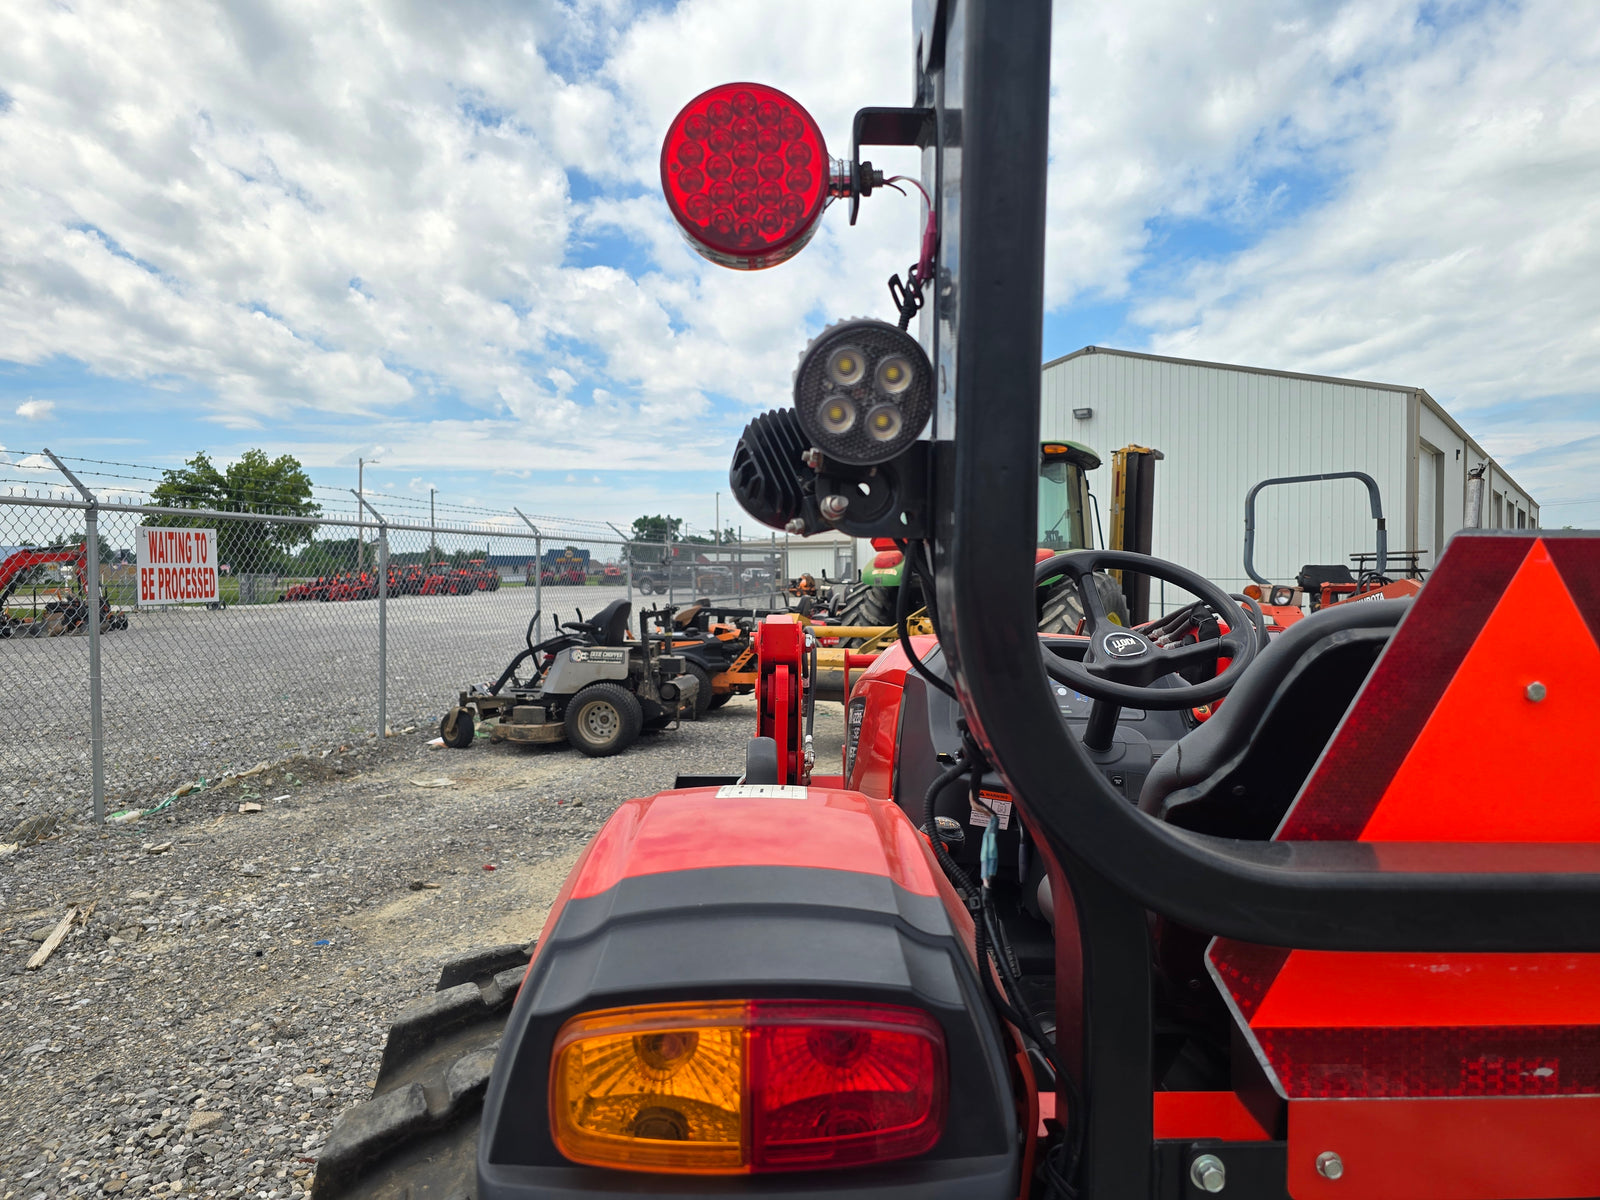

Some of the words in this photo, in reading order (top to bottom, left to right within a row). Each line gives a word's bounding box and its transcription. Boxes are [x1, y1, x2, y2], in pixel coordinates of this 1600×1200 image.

[148, 531, 192, 564] WAITING
[194, 532, 207, 564] TO
[141, 567, 155, 600] BE
[158, 567, 215, 600] PROCESSED
[1356, 591, 1385, 603] BOTA
[1111, 638, 1136, 652] KIOTI
